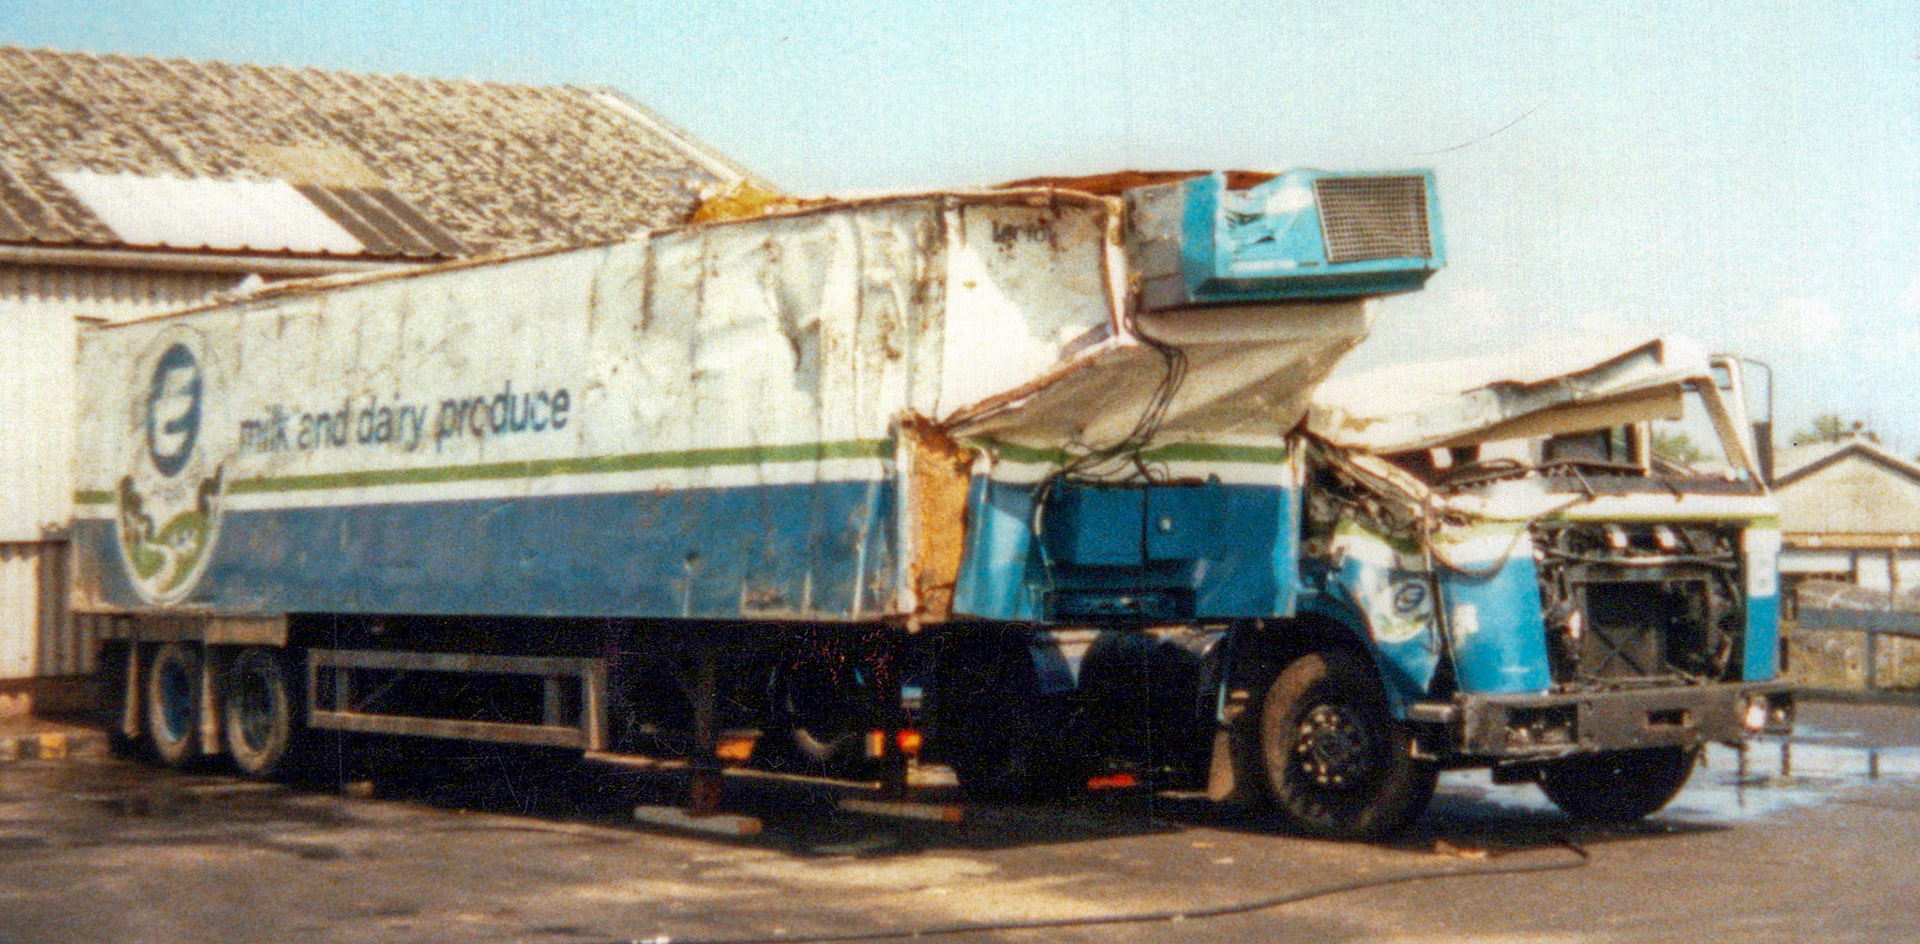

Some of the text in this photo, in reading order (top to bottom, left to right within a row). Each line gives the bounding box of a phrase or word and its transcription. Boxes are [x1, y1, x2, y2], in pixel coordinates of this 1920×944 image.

[239, 380, 570, 453] milk and dairy produce
